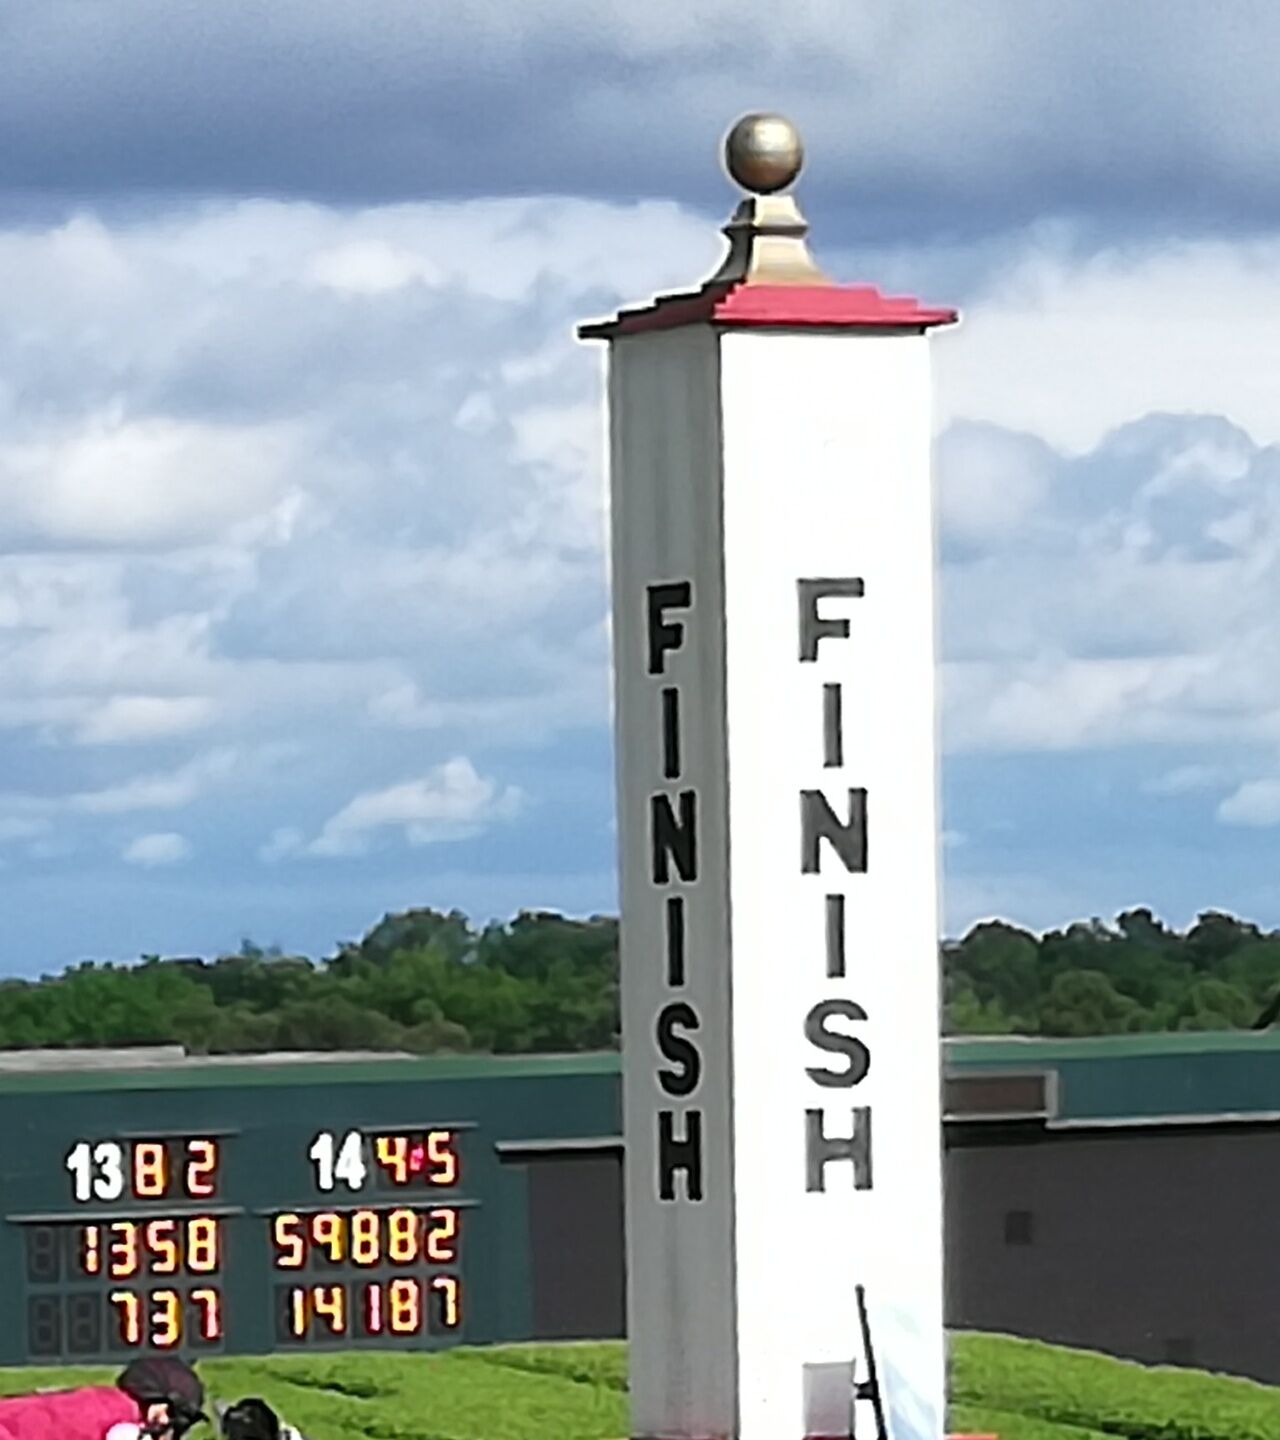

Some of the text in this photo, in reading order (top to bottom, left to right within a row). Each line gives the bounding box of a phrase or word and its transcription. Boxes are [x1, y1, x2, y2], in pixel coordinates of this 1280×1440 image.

[646, 581, 702, 1202] FINISH
[796, 577, 873, 1193] FINISH
[67, 1142, 124, 1201] 13
[310, 1131, 367, 1190] 14
[81, 1213, 217, 1276] 1358
[275, 1209, 455, 1266] 59882
[111, 1289, 219, 1345] 737
